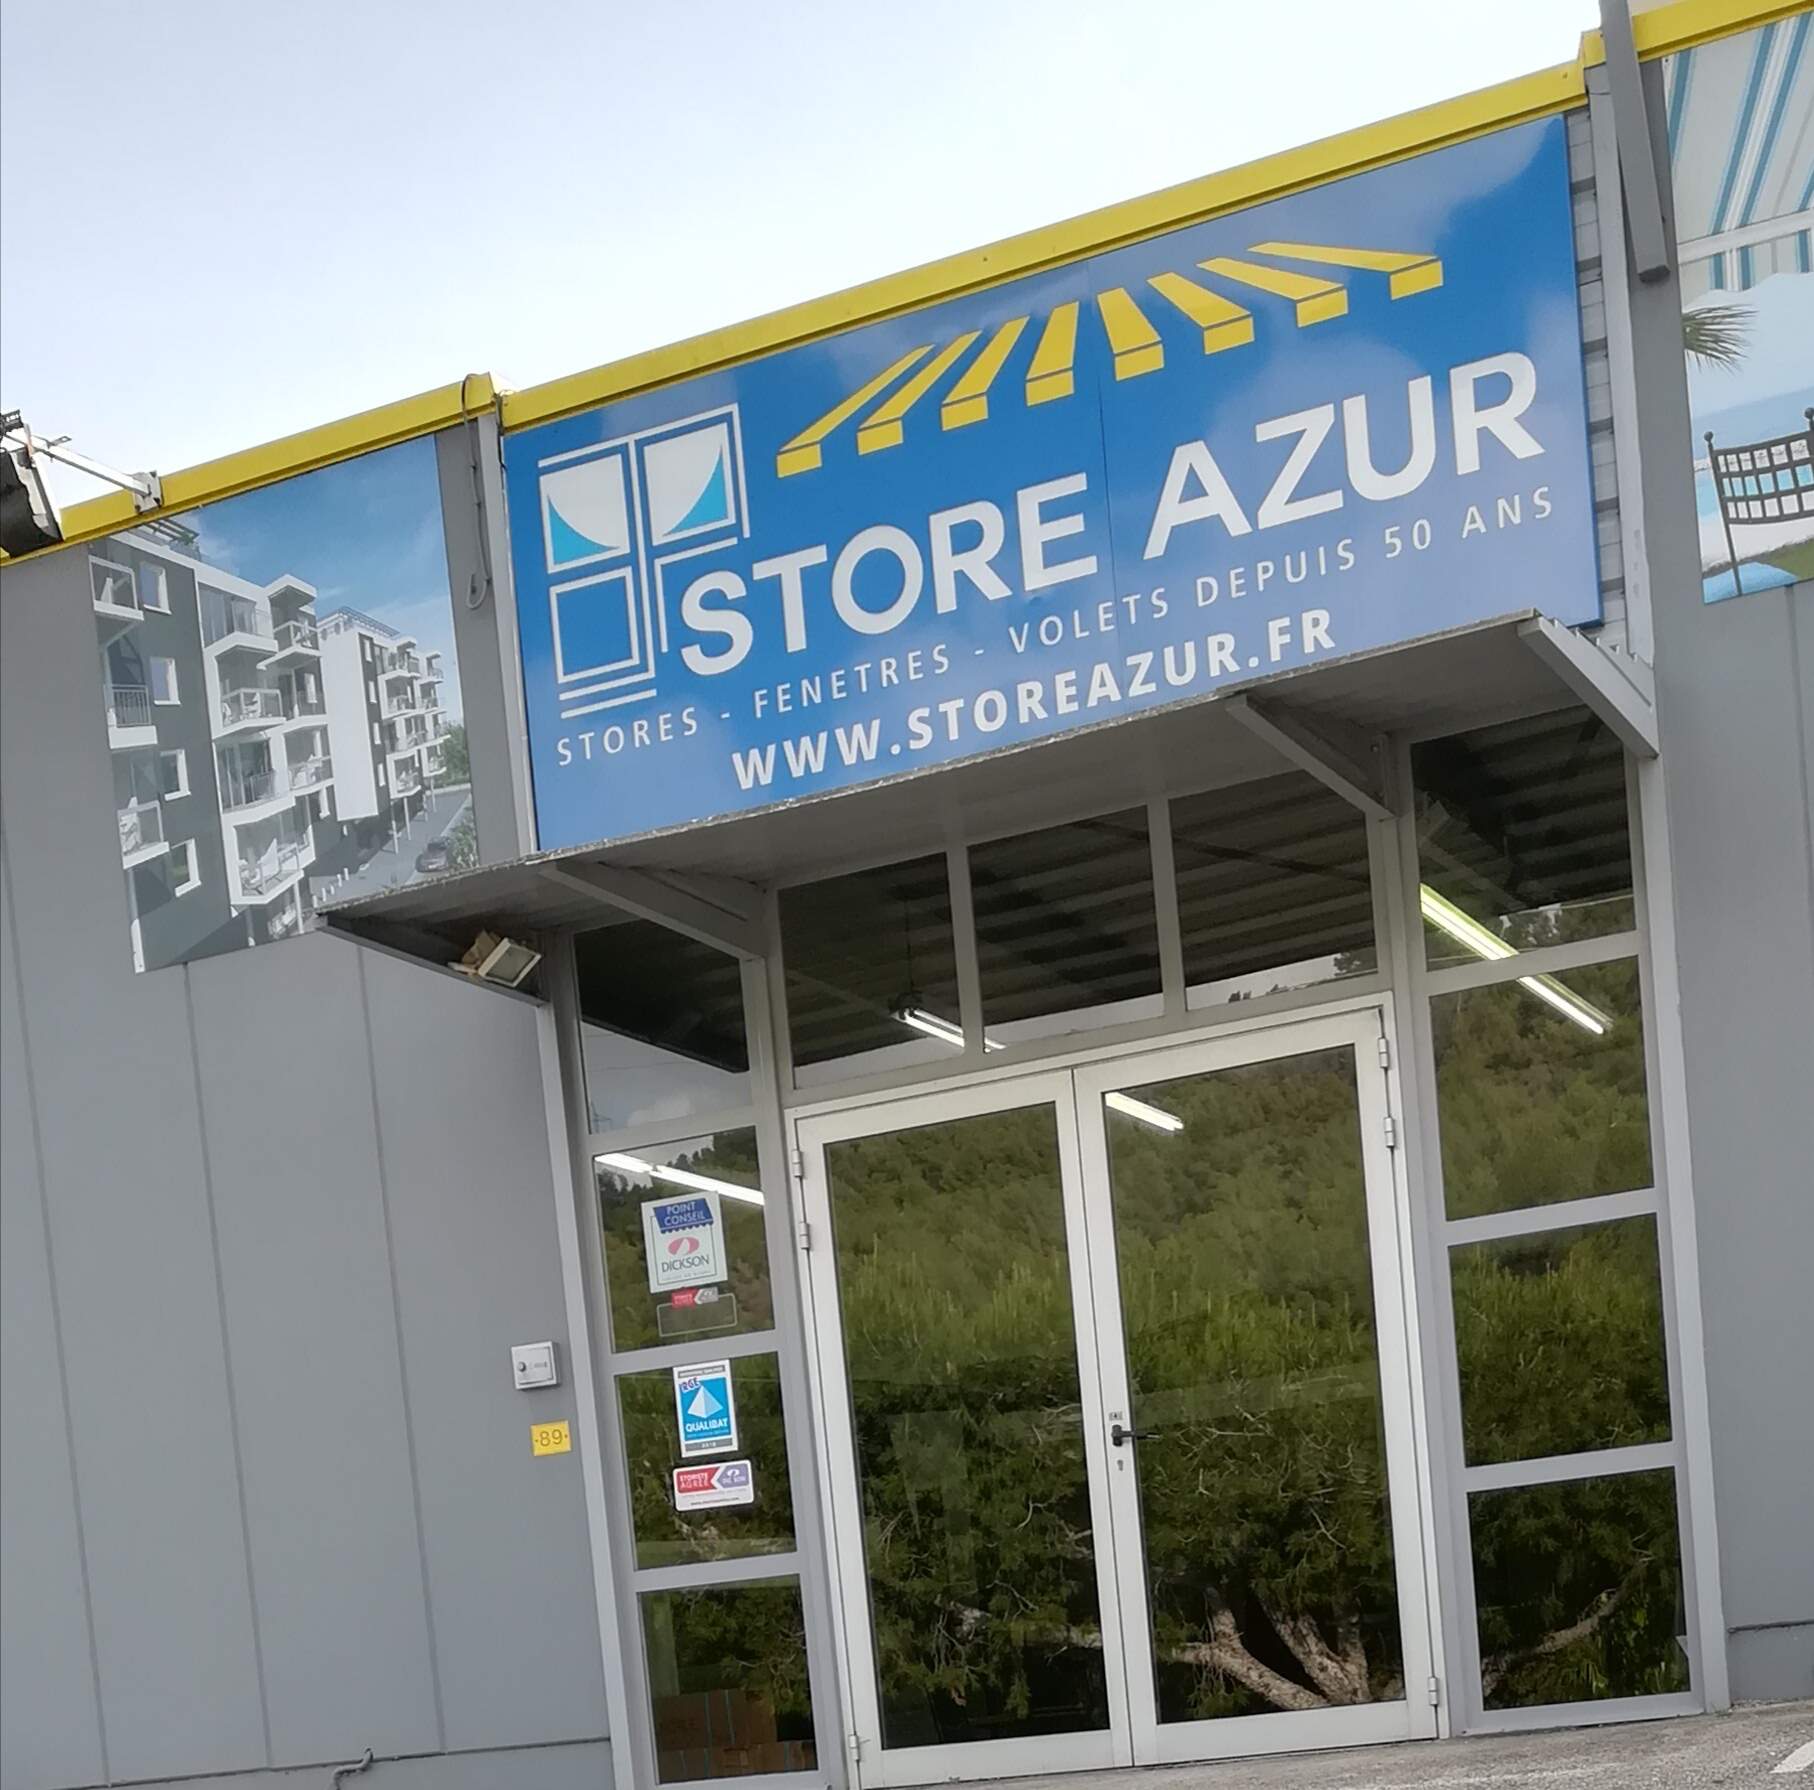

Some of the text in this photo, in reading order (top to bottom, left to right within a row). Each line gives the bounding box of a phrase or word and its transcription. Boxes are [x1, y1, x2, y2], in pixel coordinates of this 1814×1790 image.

[680, 351, 1546, 676] STORE AZUR
[556, 706, 698, 767] STORES
[753, 643, 951, 720] FENETRES
[1008, 587, 1169, 655] VOLETS
[1196, 538, 1356, 608] DEPUIS
[1384, 518, 1433, 561] 50
[1460, 485, 1553, 540] ANS
[732, 607, 1336, 791] WWW.STOREAZUR.FR
[666, 1201, 697, 1215] POINT
[664, 1211, 706, 1226] CONSEIL
[661, 1254, 710, 1273] DICKSON
[685, 1417, 729, 1433] QUALIBAT
